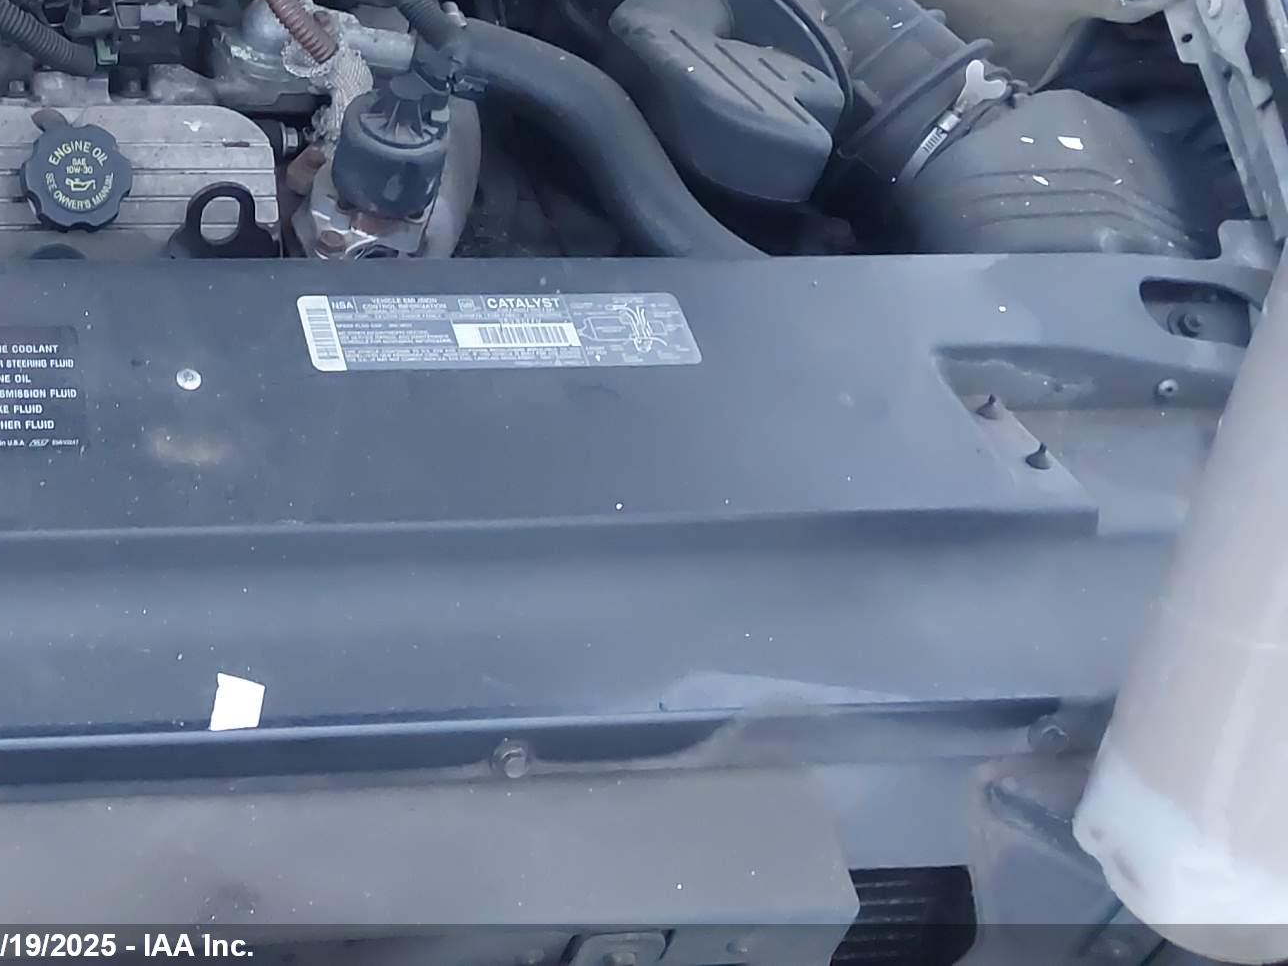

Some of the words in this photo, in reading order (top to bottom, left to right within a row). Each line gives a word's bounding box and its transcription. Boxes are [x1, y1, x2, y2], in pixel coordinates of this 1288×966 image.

[48, 140, 91, 165] ENGINE
[92, 147, 108, 167] OIL
[487, 297, 560, 309] CATALYST
[12, 344, 59, 353] COOLANT
[6, 359, 47, 368] STEERING
[50, 359, 74, 368] FLUID
[14, 374, 31, 383] OIL
[50, 388, 77, 398] FLUID
[13, 404, 43, 414] FLUID
[25, 420, 55, 429] FLUID
